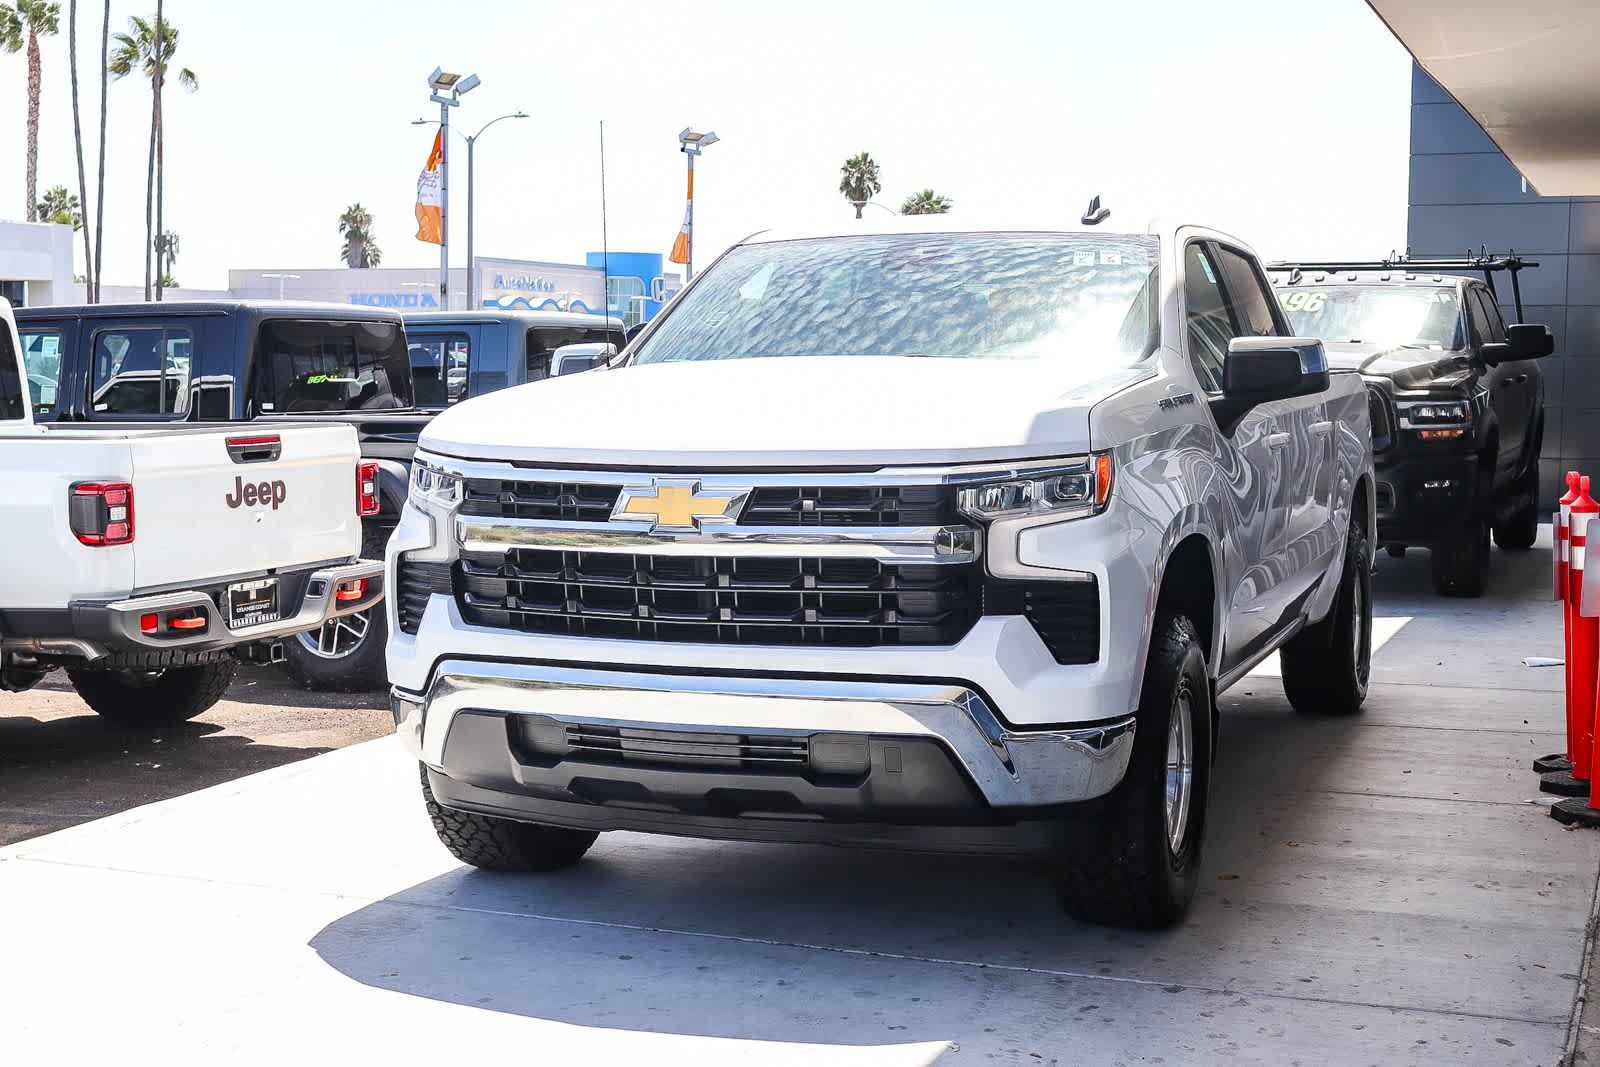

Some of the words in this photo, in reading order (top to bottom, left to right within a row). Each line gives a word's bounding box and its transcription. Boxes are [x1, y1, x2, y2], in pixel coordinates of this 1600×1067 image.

[494, 272, 554, 291] AutoNation
[351, 293, 439, 308] HONDA
[226, 476, 286, 510] Jeep
